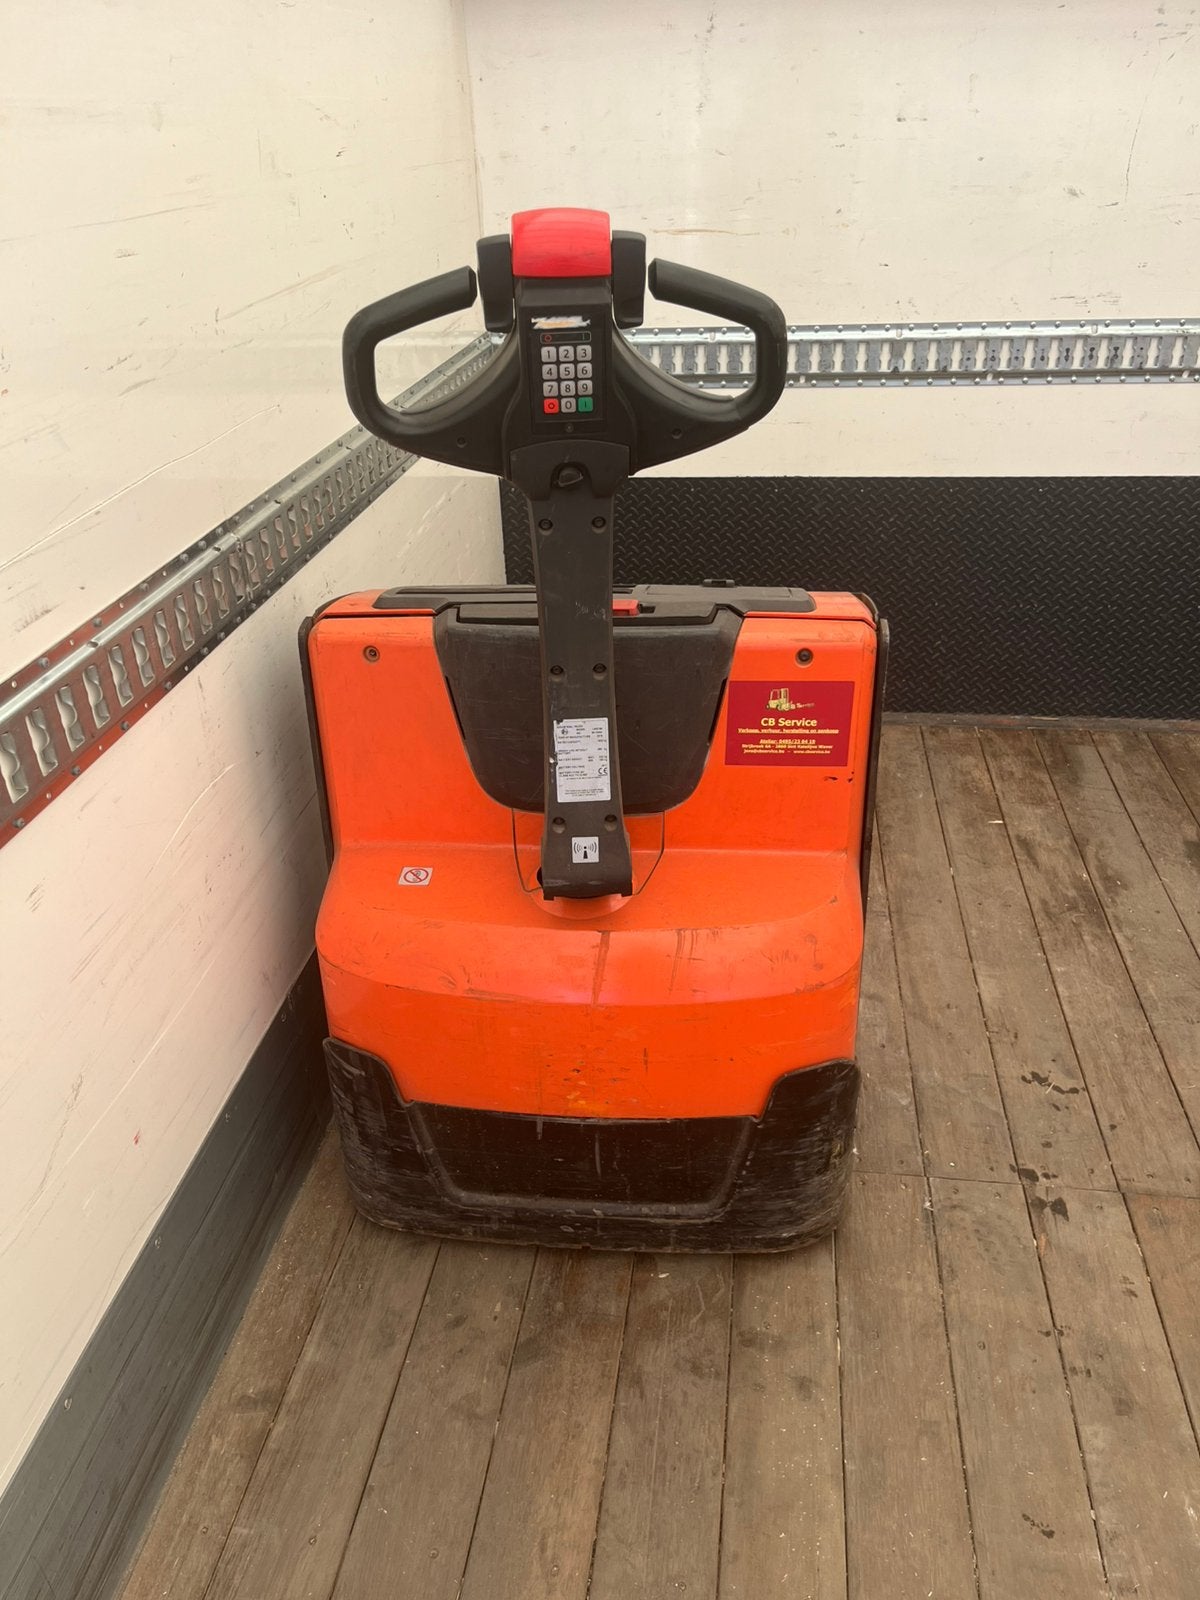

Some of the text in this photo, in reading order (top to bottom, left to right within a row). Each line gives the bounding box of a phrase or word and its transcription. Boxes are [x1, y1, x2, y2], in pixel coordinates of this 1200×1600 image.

[546, 348, 587, 359] 1 2 3
[546, 366, 588, 376] 4 5 6
[547, 383, 588, 394] 7 8 9
[564, 400, 572, 409] 0
[761, 717, 818, 727] CB Service
